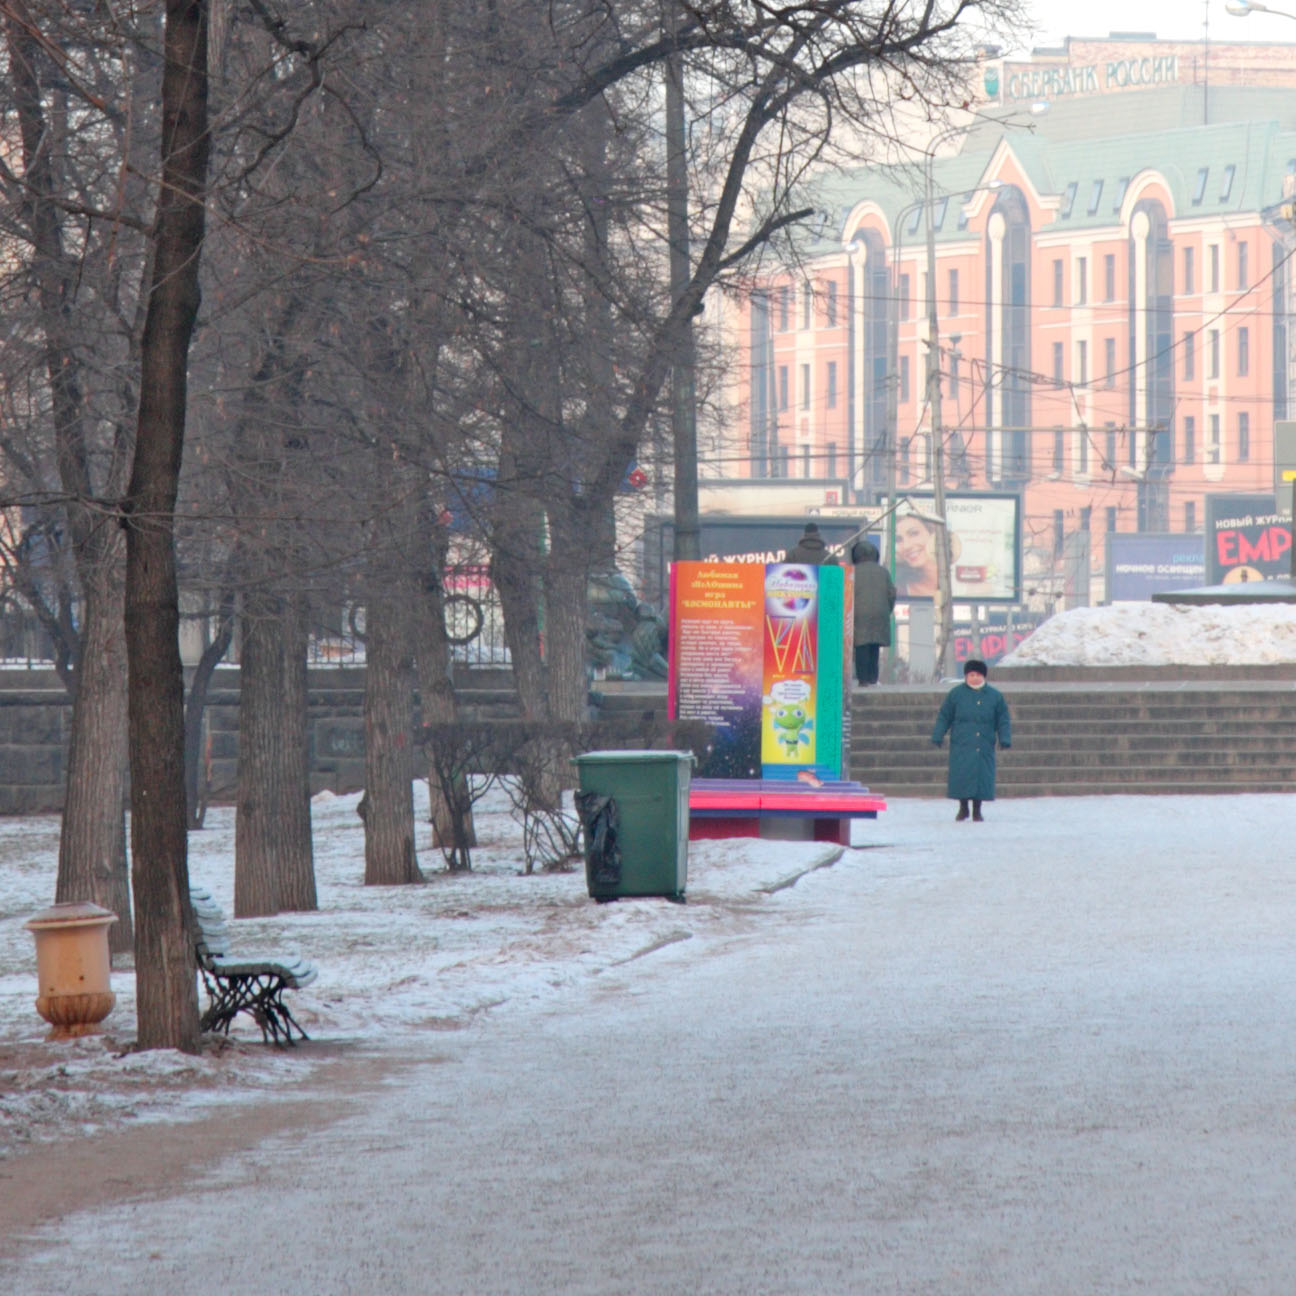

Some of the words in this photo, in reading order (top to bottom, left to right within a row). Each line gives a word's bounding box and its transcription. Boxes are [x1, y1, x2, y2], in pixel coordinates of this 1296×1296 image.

[1009, 64, 1098, 99] СБЕРБАНК
[1106, 56, 1178, 88] РОССИИ
[1215, 515, 1253, 529] НОВЫЙ
